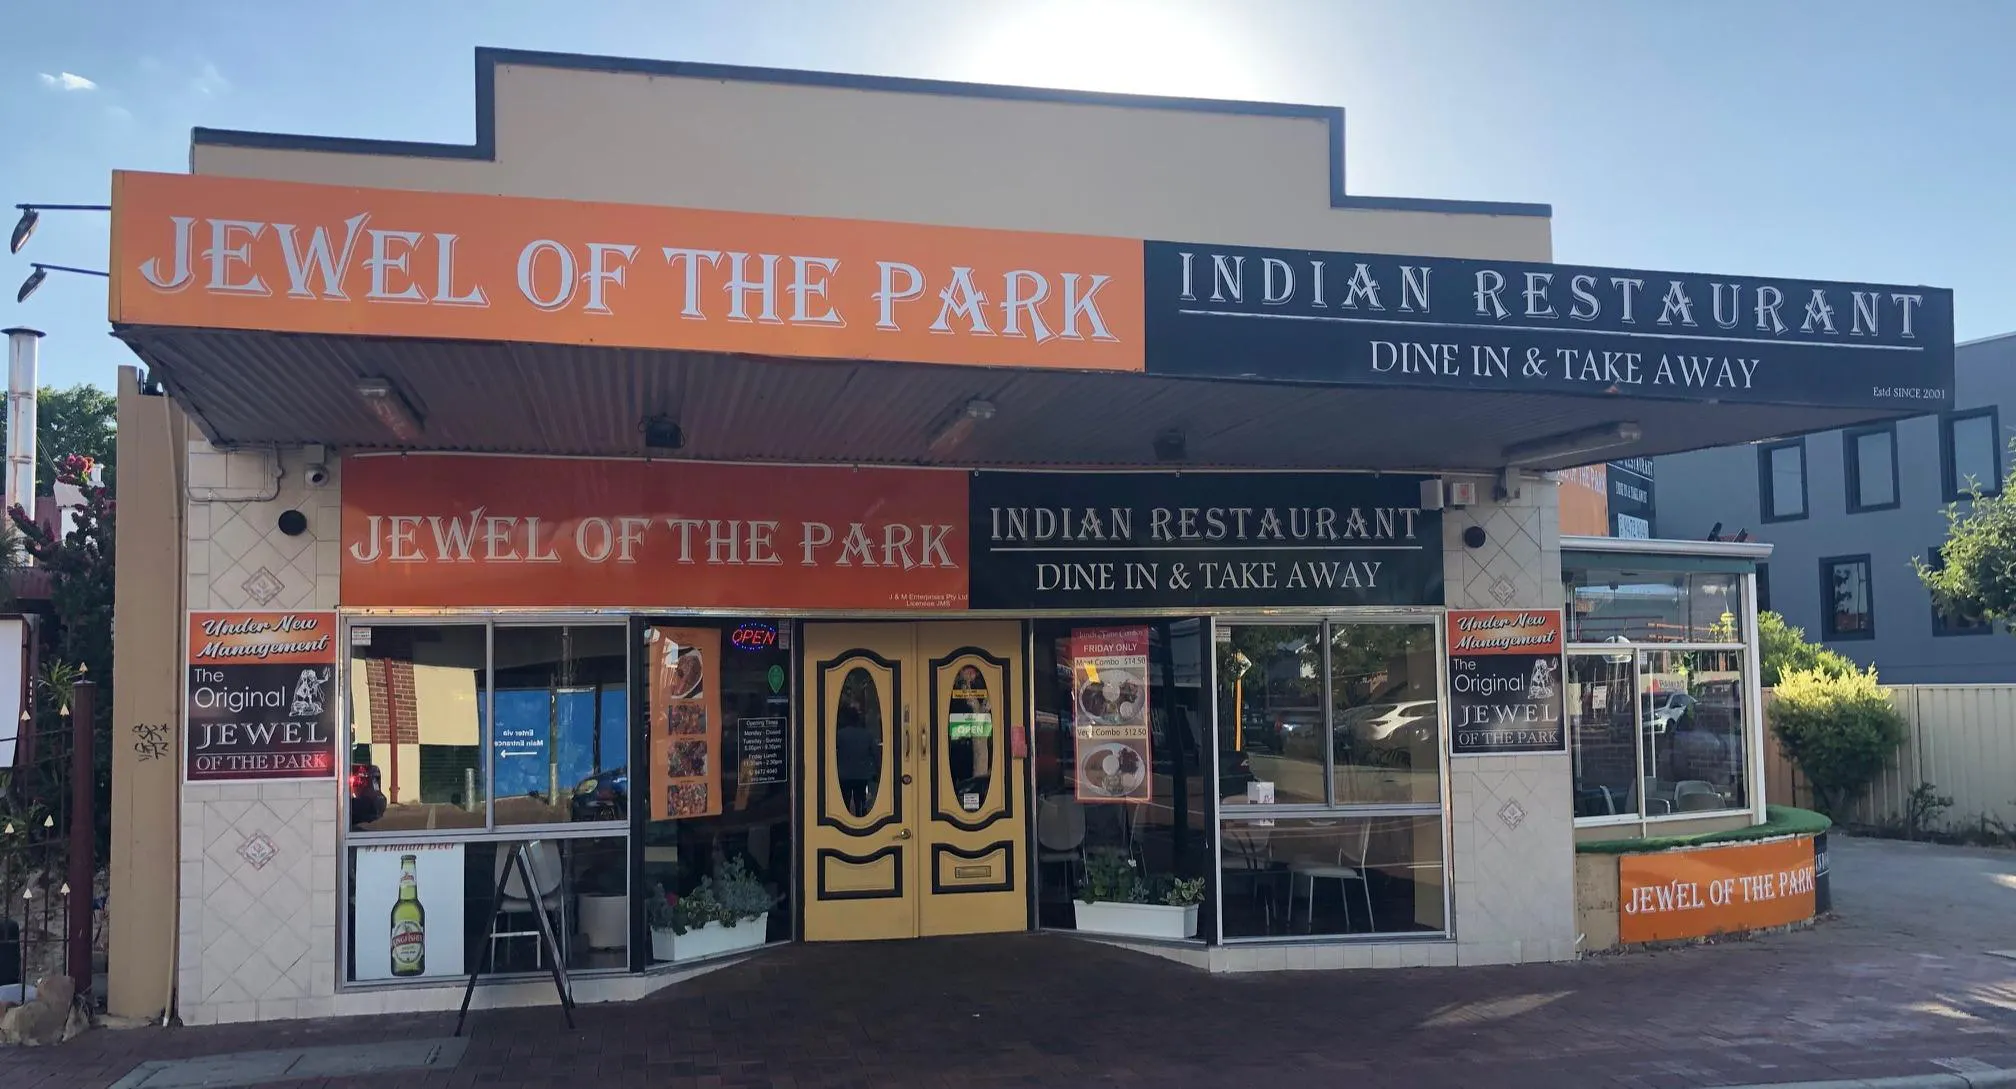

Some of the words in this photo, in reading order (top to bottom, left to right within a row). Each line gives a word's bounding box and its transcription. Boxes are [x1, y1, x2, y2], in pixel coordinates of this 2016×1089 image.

[138, 212, 490, 308] JEWEL
[516, 239, 641, 315] OF
[661, 246, 847, 328] THE
[871, 261, 1120, 344] PARK
[1178, 252, 1432, 313] INDIAN
[1472, 269, 1924, 339] RESTAURANT
[1370, 340, 1460, 376] DINE
[1471, 346, 1511, 378] IN
[1522, 347, 1548, 378] &
[1556, 348, 1644, 385] TAKE
[1653, 353, 1760, 389] AWAY
[1873, 386, 1891, 397] Estd
[1893, 387, 1921, 399] SINCE
[1923, 388, 1945, 399] 2001
[989, 507, 1133, 541] INDIAN
[1150, 507, 1421, 542] RESTAURANT
[350, 505, 561, 564] JEWEL
[576, 516, 652, 564] OF
[667, 518, 784, 567] THE
[798, 521, 959, 572] PARK
[1036, 563, 1115, 591] DINE
[1124, 563, 1159, 591] IN
[1168, 562, 1191, 590] &
[1199, 561, 1278, 589] TAKE
[1287, 561, 1383, 588] AWAY
[202, 617, 271, 637] Under
[272, 615, 318, 632] New
[1457, 614, 1510, 632] Under
[1511, 612, 1547, 630] New
[196, 634, 331, 659] Management
[732, 628, 777, 645] OPEN
[1083, 643, 1115, 653] FRIDAY
[1116, 642, 1138, 652] ONLY
[1454, 629, 1557, 651] Management
[1095, 658, 1120, 666] Combo
[1124, 657, 1145, 665] $14.50
[1453, 658, 1477, 671] The
[194, 668, 224, 683] The
[1454, 673, 1525, 696] Original
[194, 686, 286, 713] Original
[1458, 703, 1558, 728] JEWEL
[196, 721, 328, 750] JEWEL
[956, 725, 985, 735] OPEN
[1096, 728, 1120, 736] Combo
[1124, 728, 1147, 736] $12.50
[1458, 732, 1481, 745] OF
[1482, 731, 1515, 745] THE
[1517, 729, 1559, 744] PARK
[196, 755, 223, 771] OF
[226, 754, 269, 770] THE
[273, 752, 328, 769] PARK
[1625, 878, 1706, 914] JEWEL
[1709, 877, 1736, 906] OF
[1739, 872, 1777, 902] THE
[1779, 866, 1815, 896] PARK
